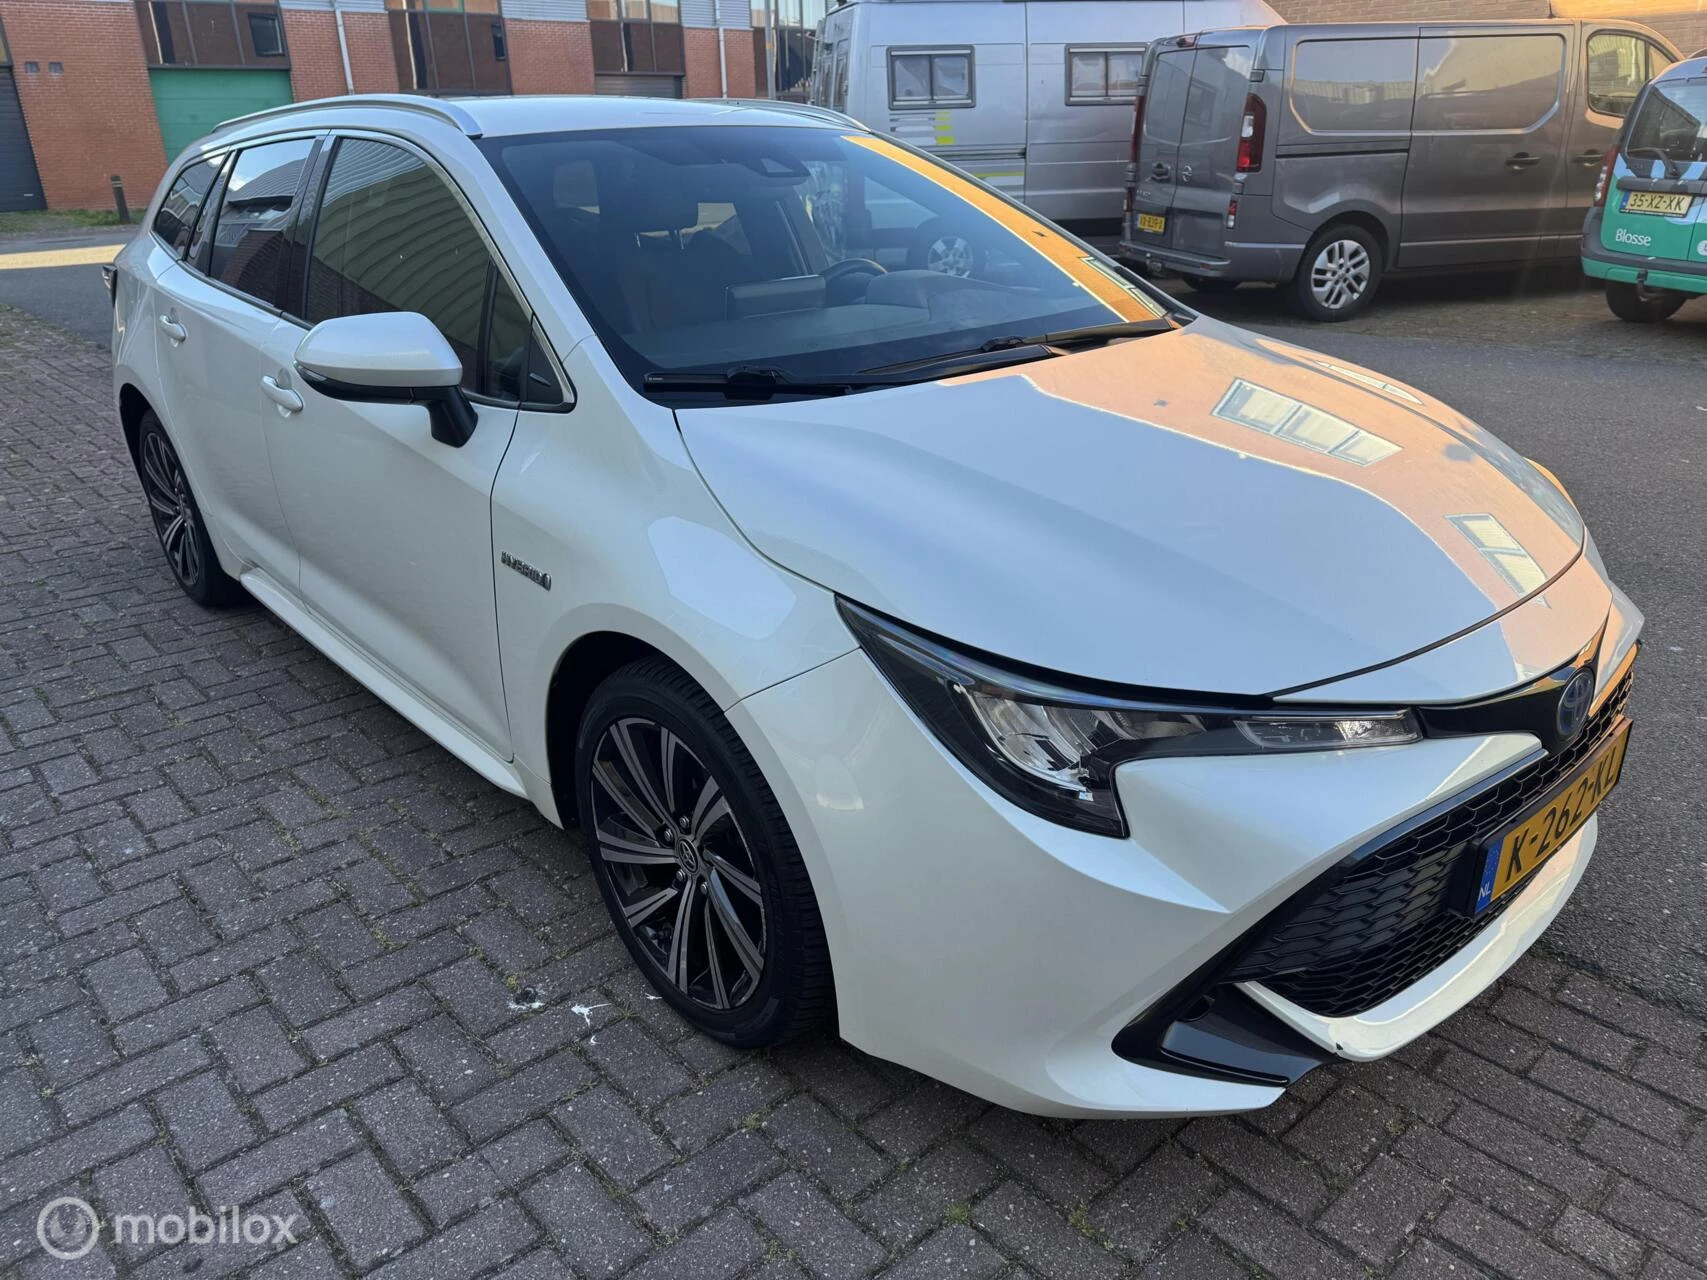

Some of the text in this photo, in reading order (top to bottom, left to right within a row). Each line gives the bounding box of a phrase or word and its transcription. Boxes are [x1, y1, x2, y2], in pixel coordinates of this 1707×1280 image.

[1630, 194, 1685, 211] 35-XZ-XK
[1615, 228, 1652, 246] Blosse
[1504, 746, 1618, 882] K-262-KL
[1478, 881, 1492, 901] NL
